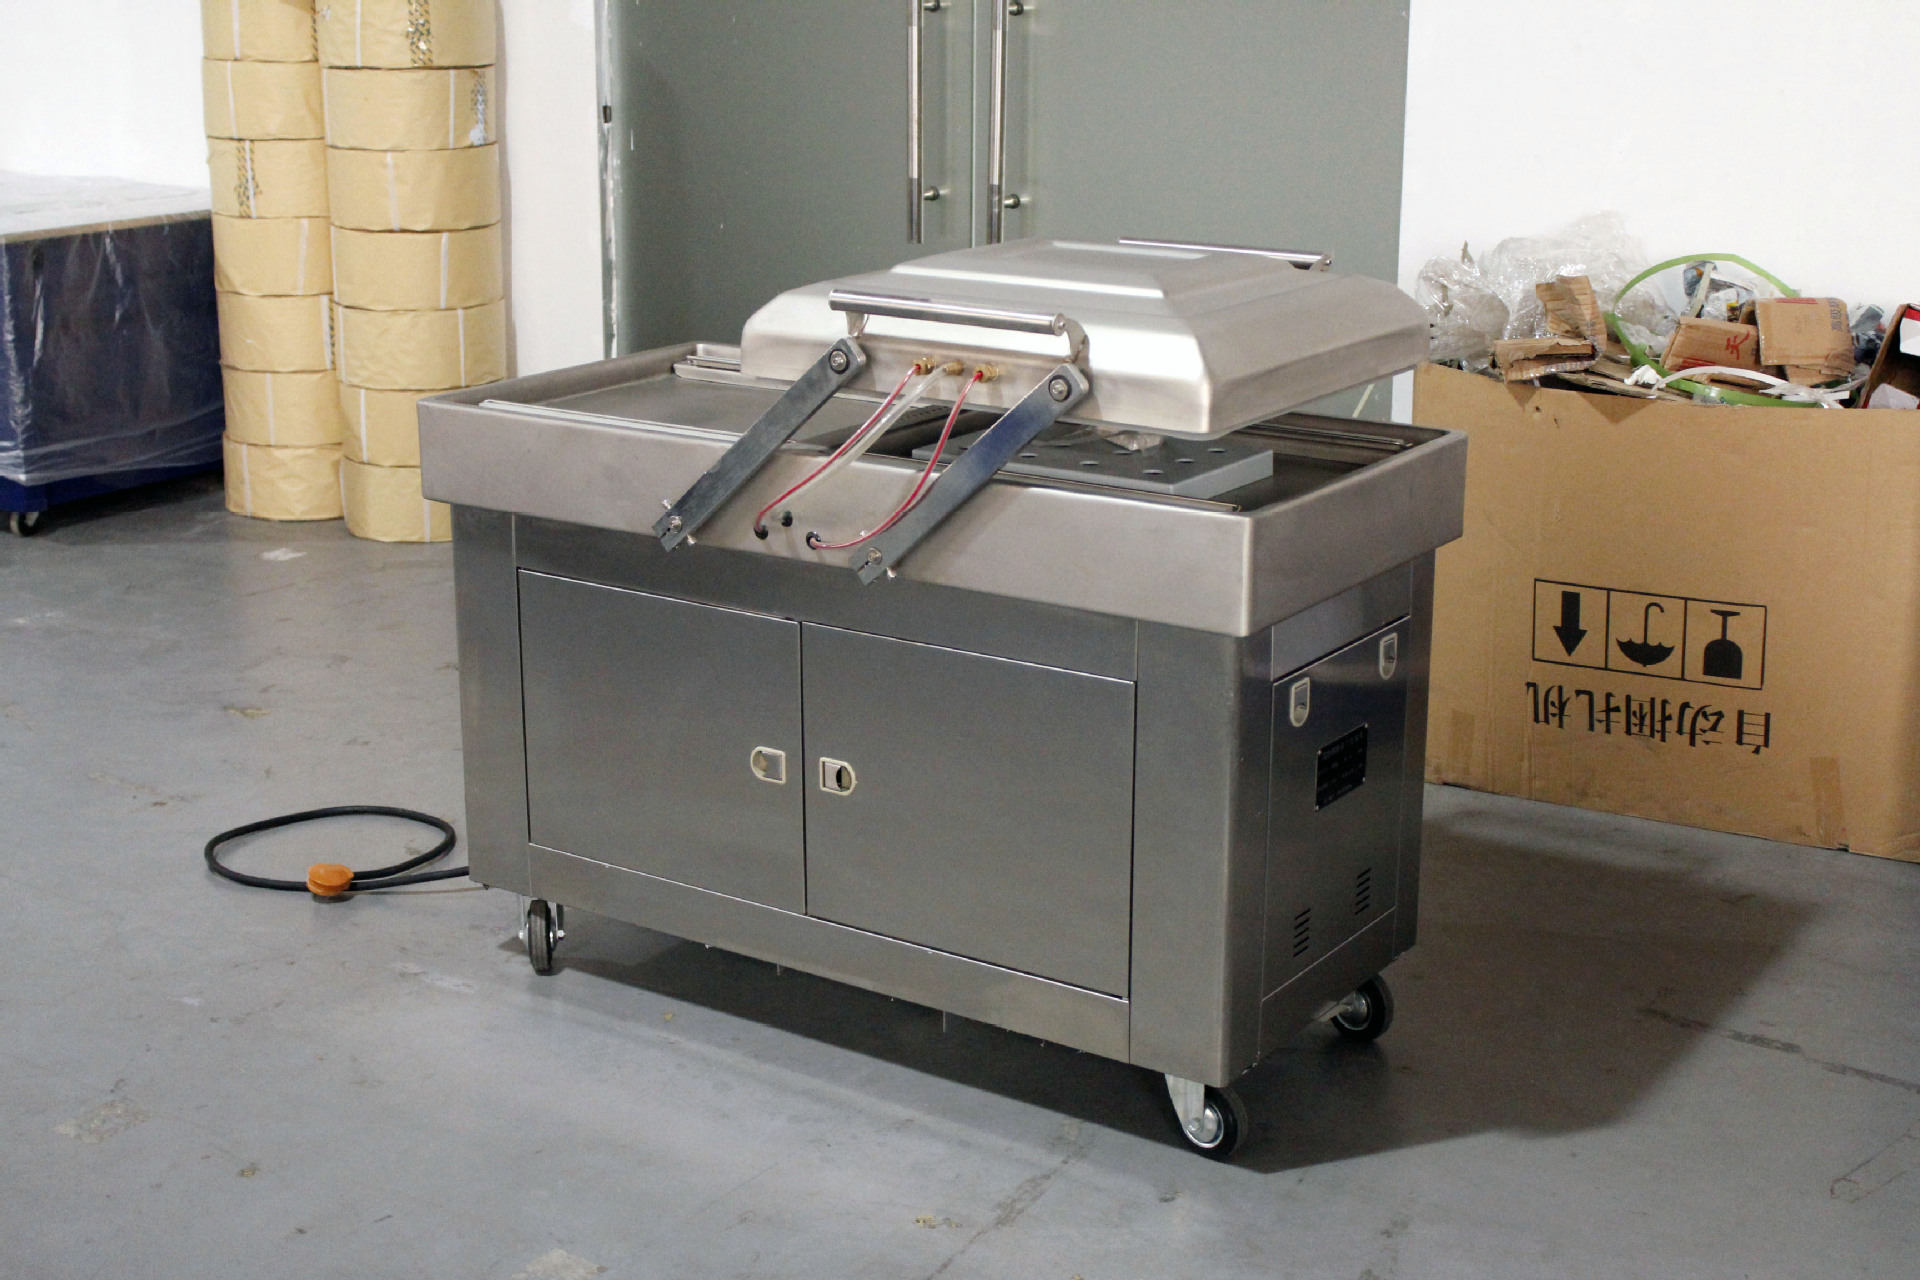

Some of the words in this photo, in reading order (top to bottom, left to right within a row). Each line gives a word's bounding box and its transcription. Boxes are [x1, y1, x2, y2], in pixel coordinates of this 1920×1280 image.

[1525, 682, 1771, 754] 自动捆扎机
